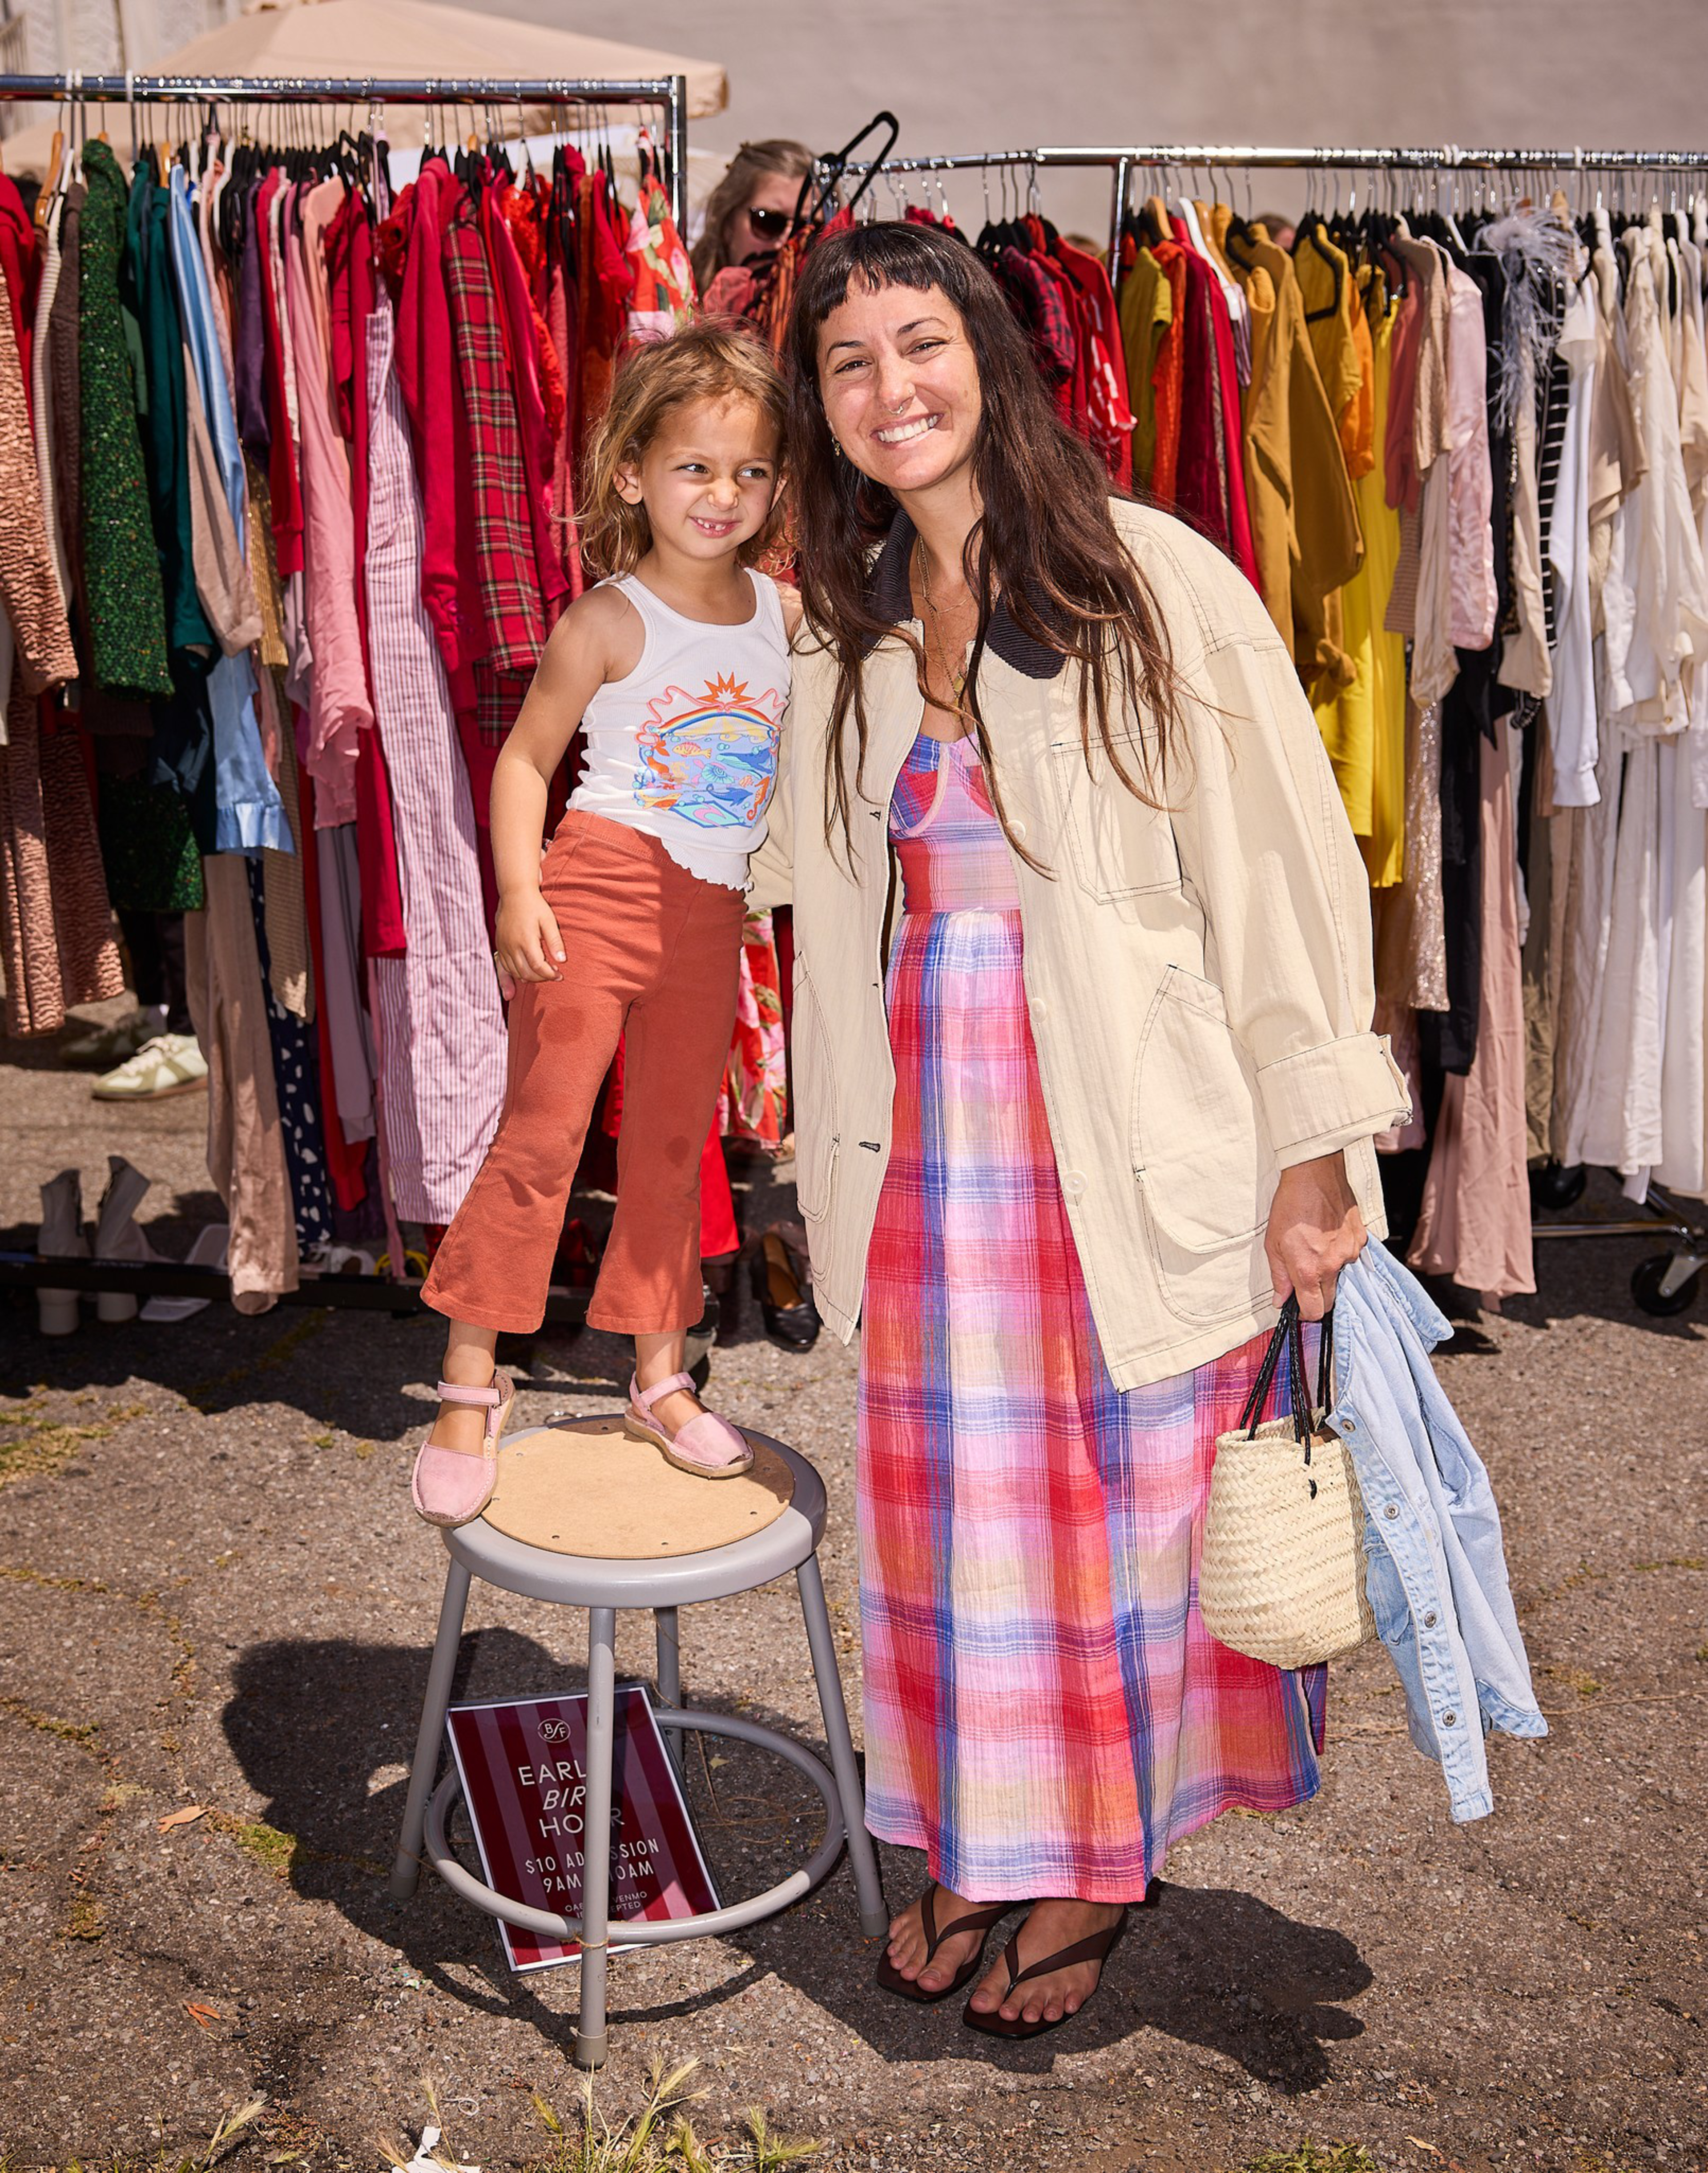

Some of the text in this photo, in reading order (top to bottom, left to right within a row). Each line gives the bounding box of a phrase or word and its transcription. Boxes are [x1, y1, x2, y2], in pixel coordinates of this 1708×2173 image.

[518, 1759, 586, 1785] EARL
[543, 1786, 586, 1810] BIR
[539, 1808, 624, 1838] HOR
[525, 1838, 659, 1874] $10 ADSSION
[543, 1873, 581, 1893] 9AM
[613, 1891, 647, 1903] VENMO
